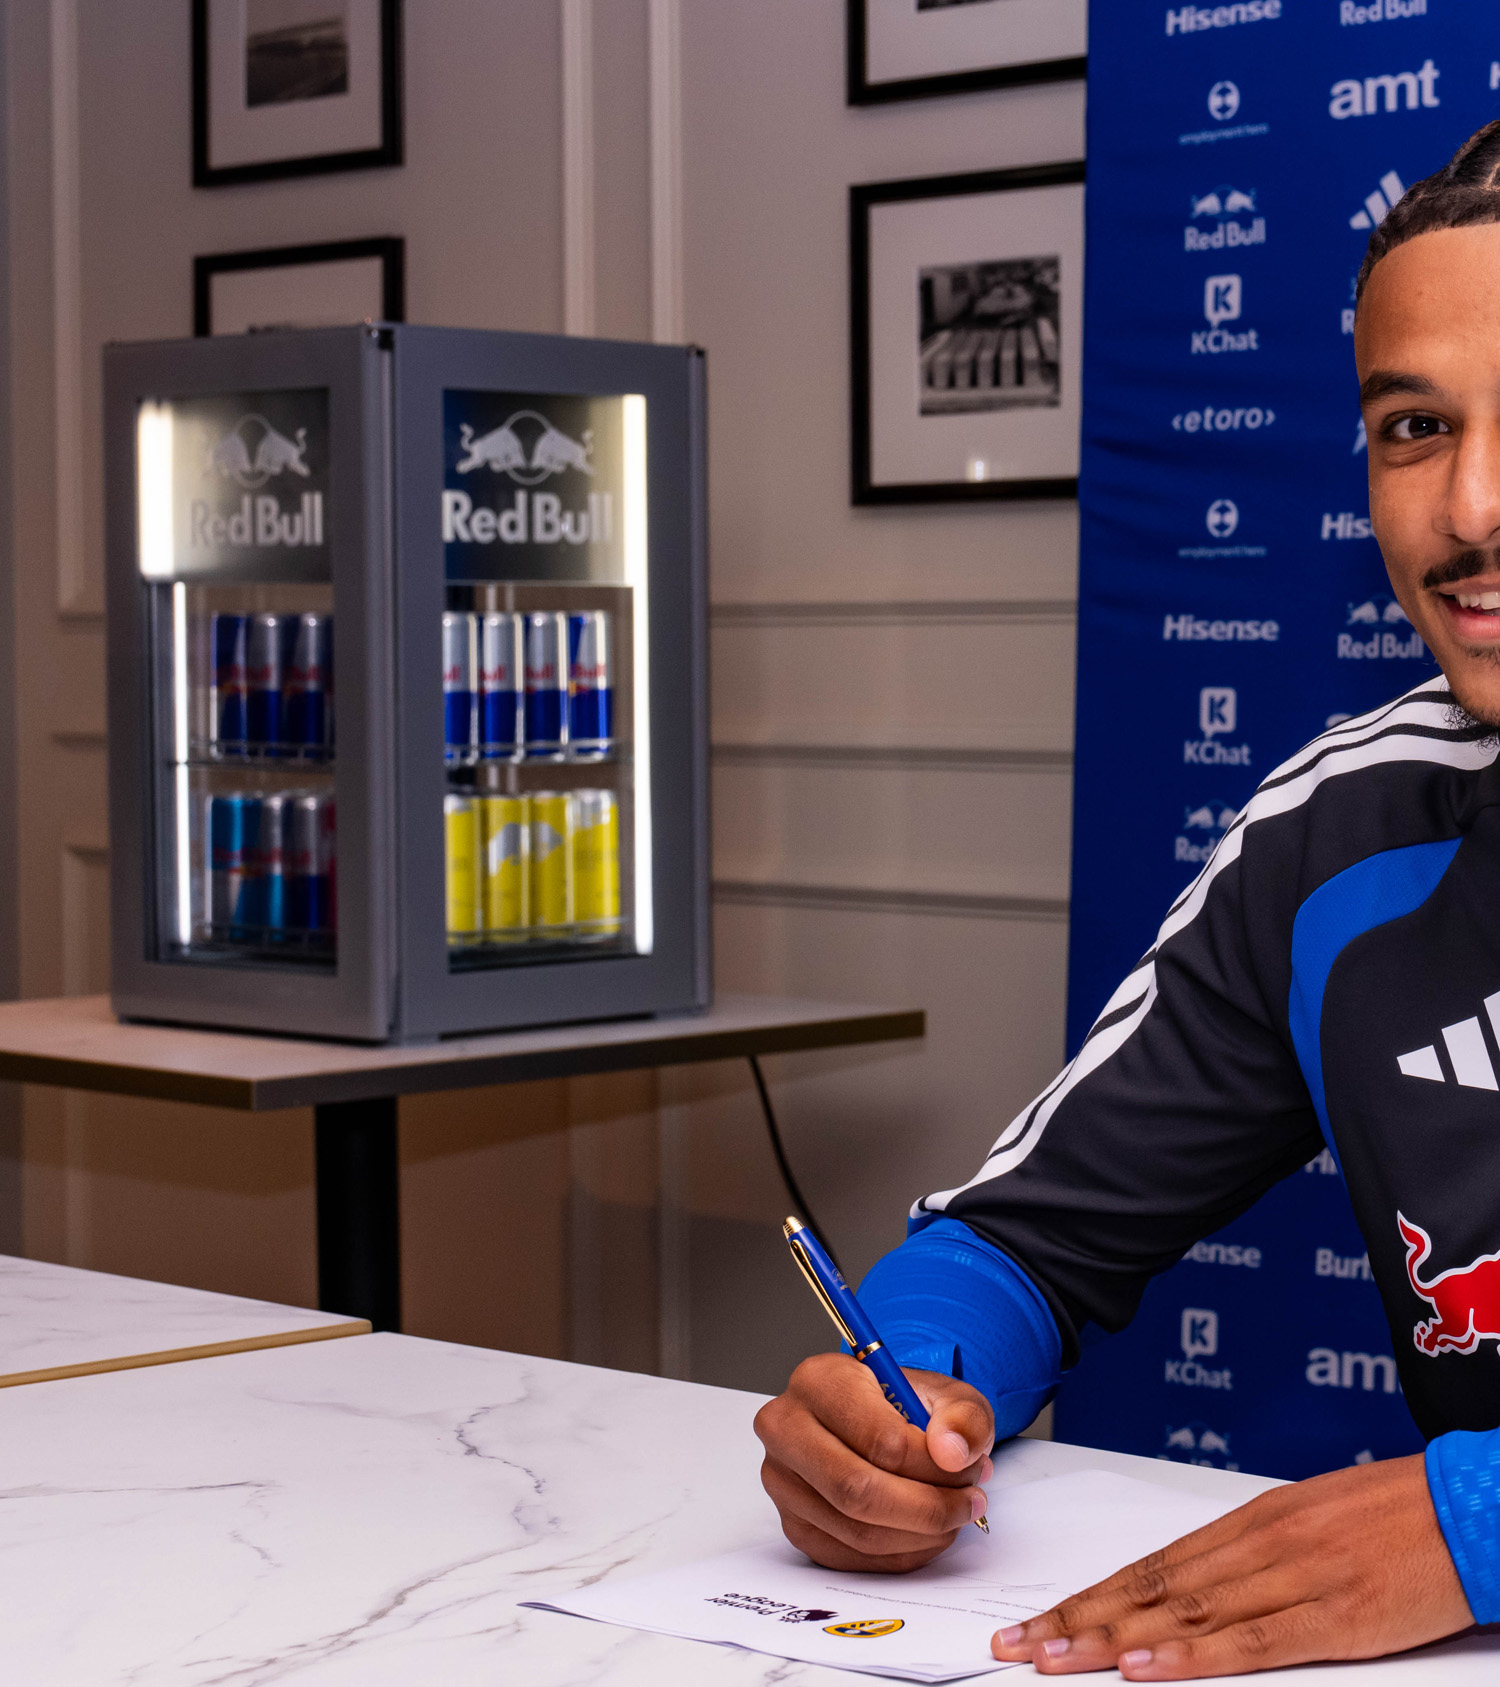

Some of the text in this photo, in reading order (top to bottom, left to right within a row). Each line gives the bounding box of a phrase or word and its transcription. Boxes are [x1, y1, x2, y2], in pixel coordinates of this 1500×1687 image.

[1165, 0, 1282, 36] Hisense
[1329, 59, 1440, 120] amt
[1184, 218, 1266, 251] Red Bull
[1190, 328, 1259, 354] KChat
[256, 491, 323, 546] Bull
[443, 491, 613, 544] Red Bull
[1163, 614, 1279, 641] Hisense
[1337, 631, 1425, 659] Red Bull
[1183, 741, 1251, 766] KChat
[1181, 1240, 1262, 1269] ense
[1164, 1360, 1232, 1390] KChat
[1305, 1348, 1401, 1395] am
[703, 1597, 782, 1616] Premier
[723, 1592, 799, 1612] League
